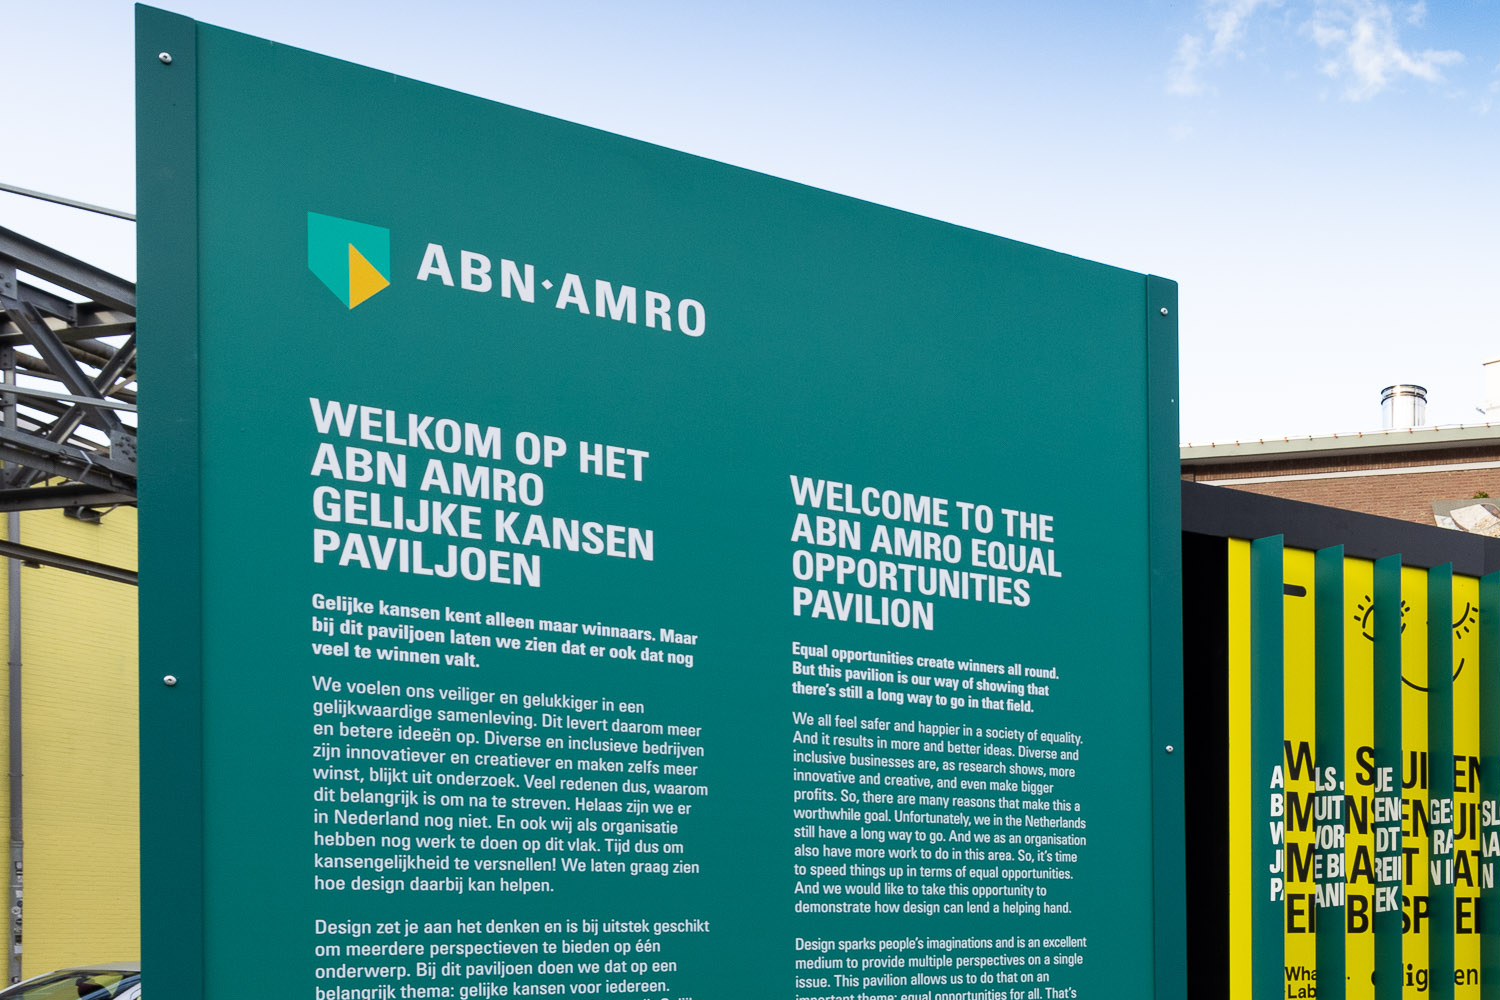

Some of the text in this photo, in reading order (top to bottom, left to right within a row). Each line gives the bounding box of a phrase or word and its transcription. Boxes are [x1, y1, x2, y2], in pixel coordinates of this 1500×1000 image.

[309, 396, 650, 482] WELKOM OP HET
[310, 442, 545, 507] ABN AMRO
[313, 485, 654, 562] GELIJKE KANSEN
[789, 474, 1055, 544] WELCOME TO THE
[313, 527, 541, 588] PAVILJOEN
[790, 512, 1062, 578] ABN AMRO EQUAL
[792, 549, 1031, 608] OPPORTUNITIES
[312, 592, 698, 645] Gelijke kansen kent alleen maar winnaars. Maar
[792, 586, 934, 631] PAVILION
[311, 641, 480, 668] veel te winnen valt.
[312, 616, 694, 669] bij dit paviljoen laten we zien dat er ook dat nog
[791, 641, 1059, 679] Equal opportunities create winners all round.
[792, 660, 1050, 697] But this pavilion is our way of showing that
[838, 685, 863, 699] still
[866, 689, 875, 700] a
[877, 687, 905, 706] long
[906, 693, 934, 708] way
[934, 693, 948, 706] to
[950, 696, 966, 710] go
[967, 694, 980, 709] in
[981, 696, 1005, 711] that
[1005, 698, 1034, 713] field.
[314, 874, 555, 895] hoe design daarbij kan helpen.
[794, 899, 1072, 917] demonstrate how design can lend a helping hand.
[399, 983, 455, 999] thema:
[459, 982, 508, 1000] gelijke
[513, 981, 566, 996] kansen
[569, 982, 602, 994] voor
[605, 978, 670, 993] iedereen.
